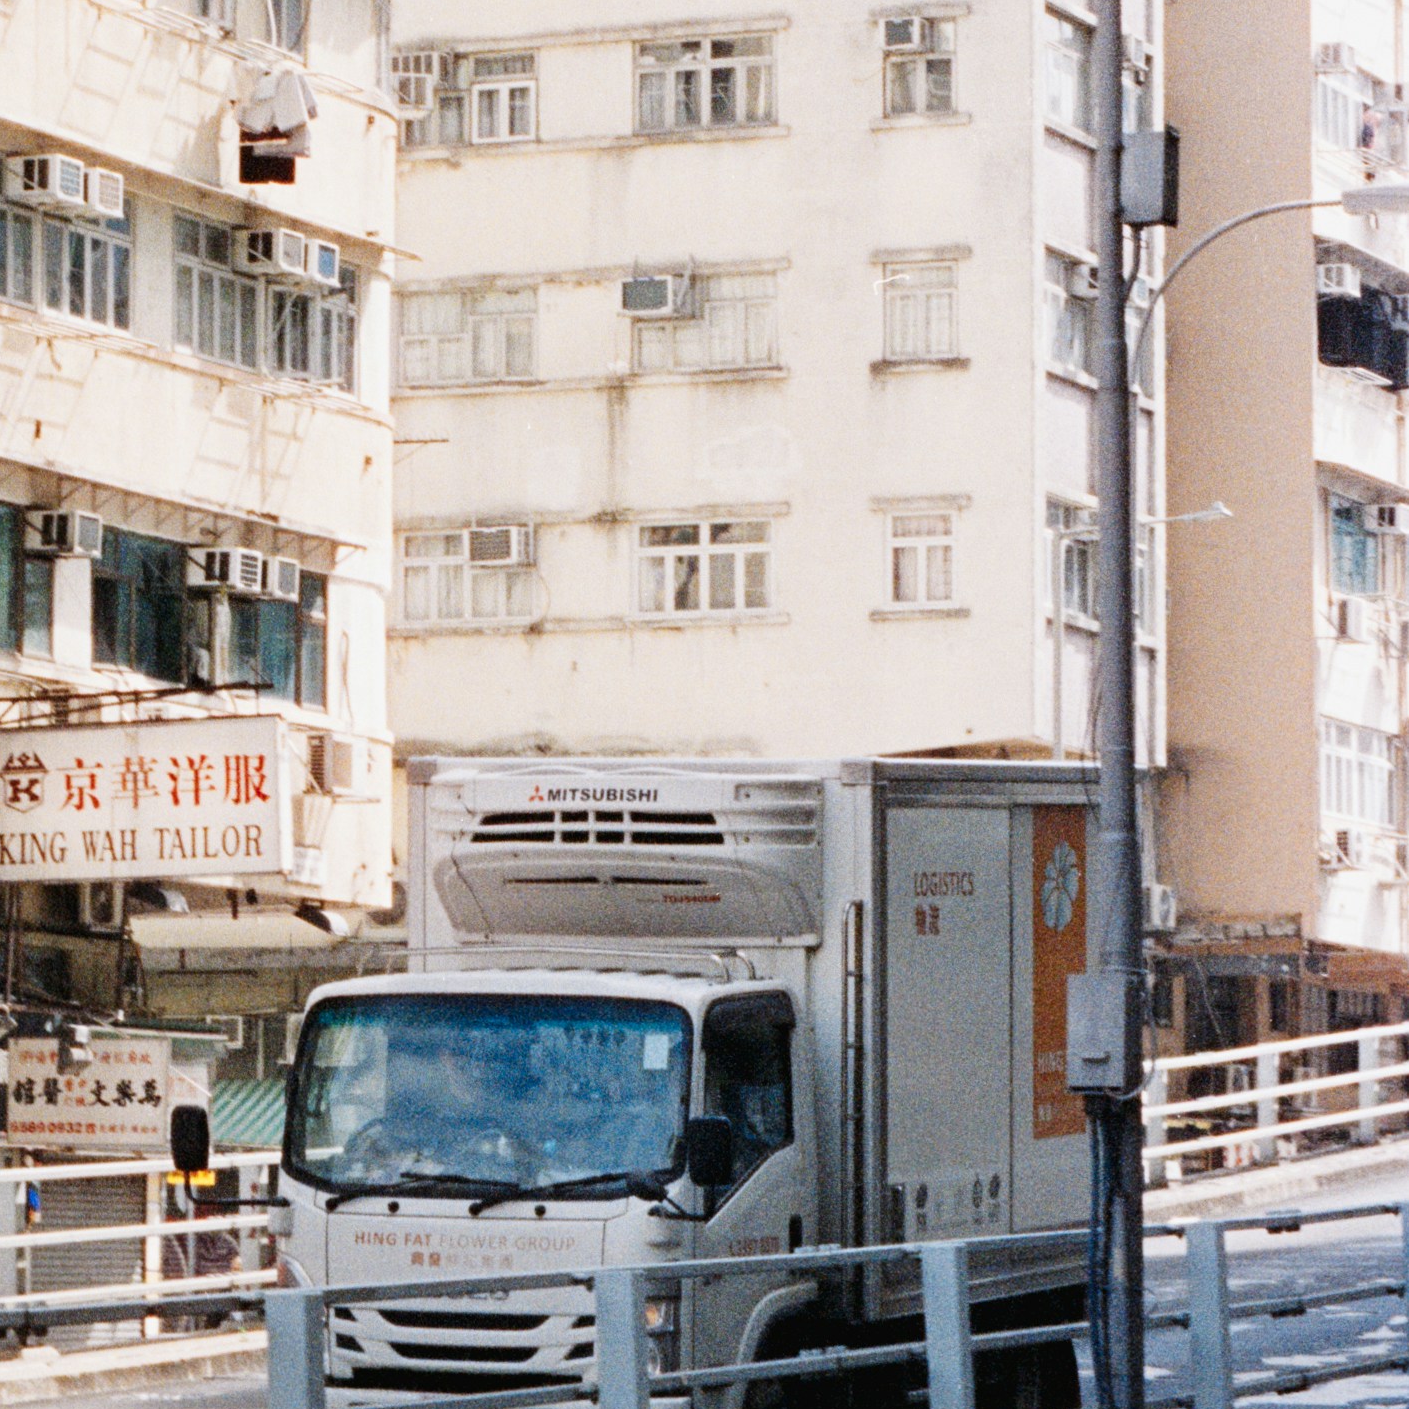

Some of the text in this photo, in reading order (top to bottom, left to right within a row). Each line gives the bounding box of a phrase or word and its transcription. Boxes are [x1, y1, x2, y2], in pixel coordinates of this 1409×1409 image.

[54, 754, 271, 811] 京華洋服
[547, 787, 659, 803] MITSUBISHI
[82, 828, 139, 863] WAH
[154, 823, 263, 860] TAILOR
[912, 870, 976, 898] LOGISTICS
[354, 1230, 577, 1252] HING FAT FLOWER GROUP
